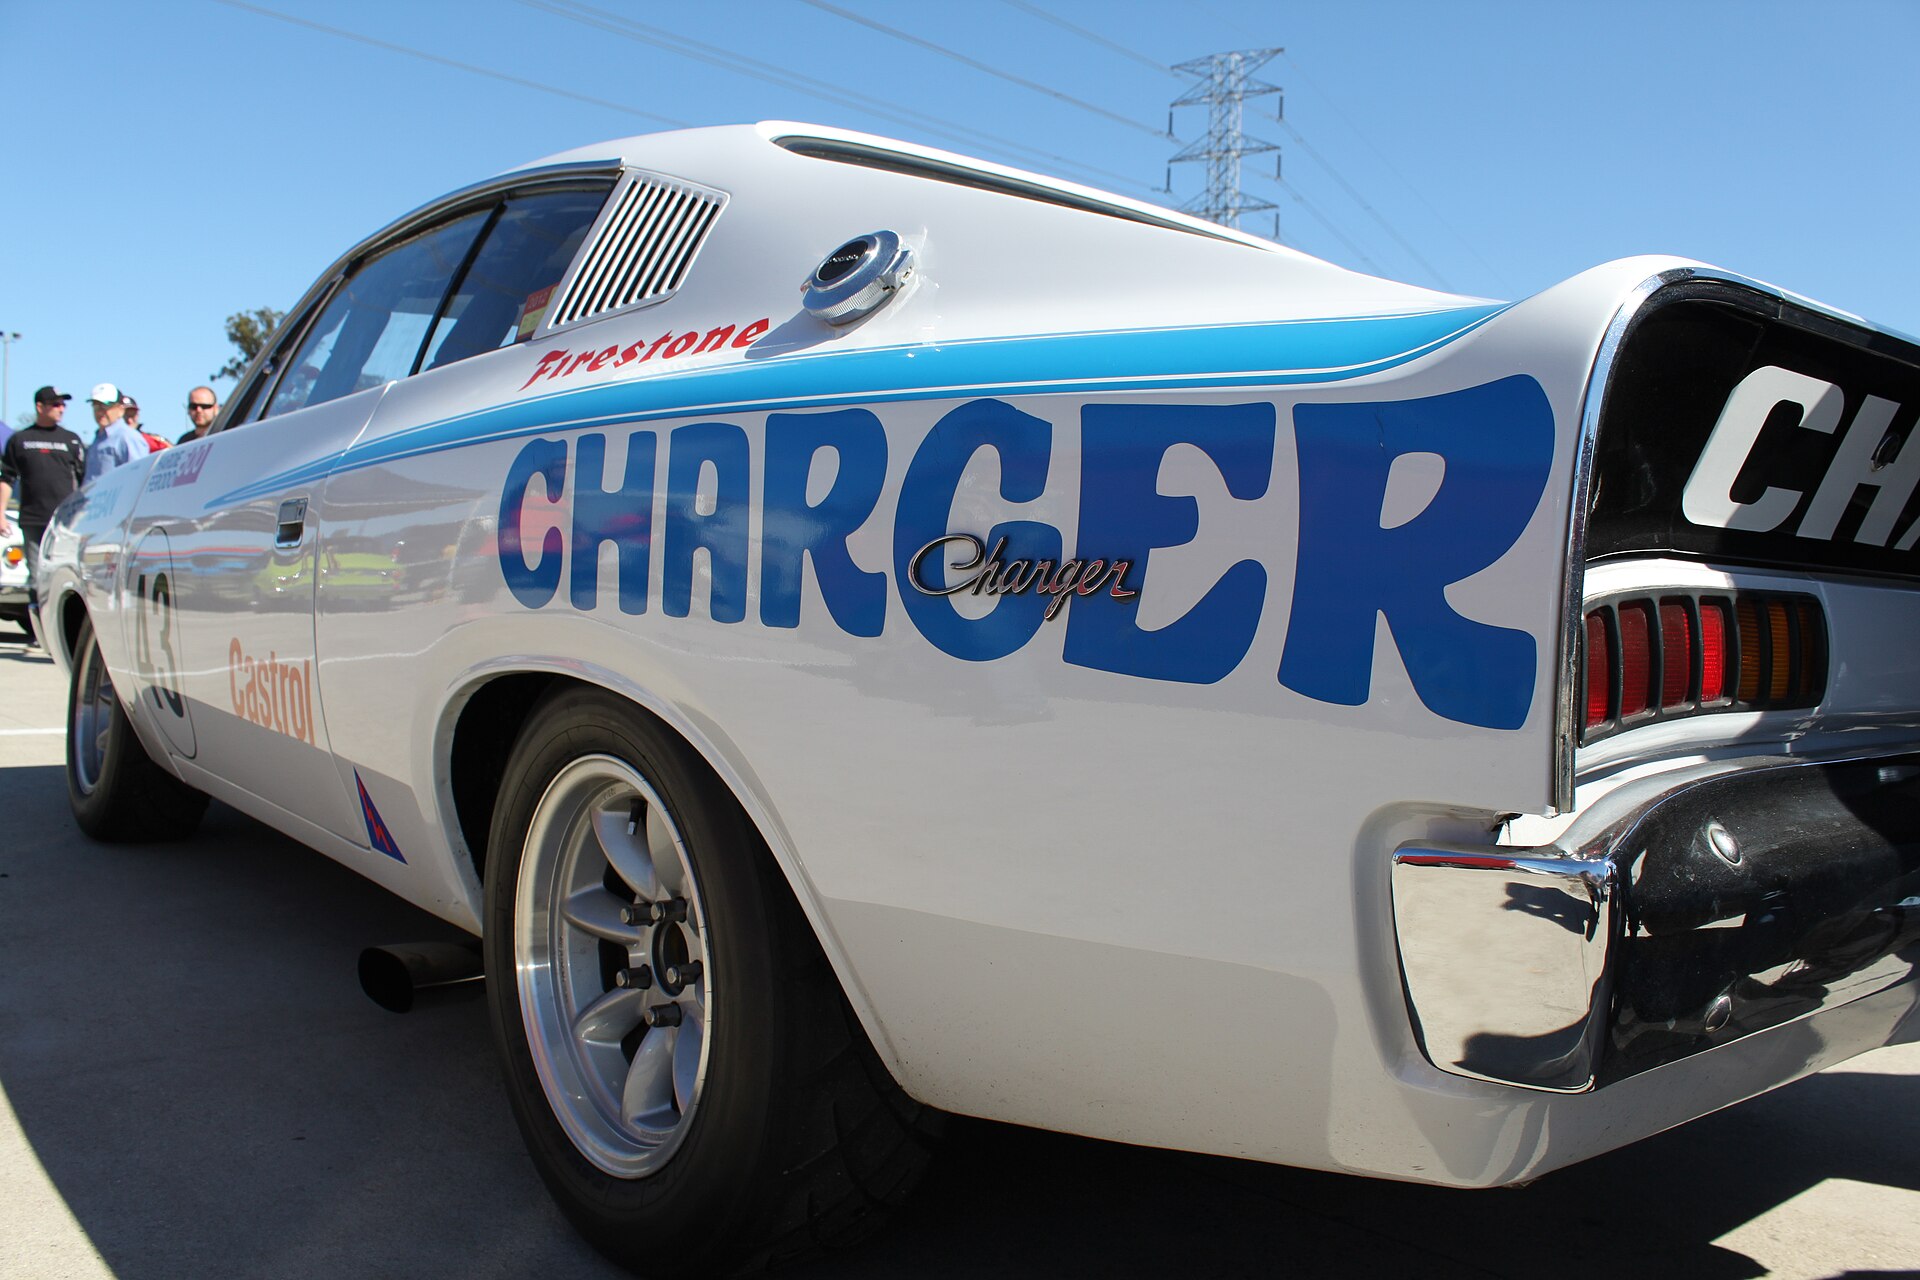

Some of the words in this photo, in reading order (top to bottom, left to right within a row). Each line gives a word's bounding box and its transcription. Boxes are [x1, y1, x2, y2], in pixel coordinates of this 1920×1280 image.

[517, 318, 770, 392] Firestone
[498, 373, 1555, 731] CHARGER
[908, 533, 1137, 620] Charger
[136, 572, 184, 718] 43
[228, 637, 315, 746] Castrol
